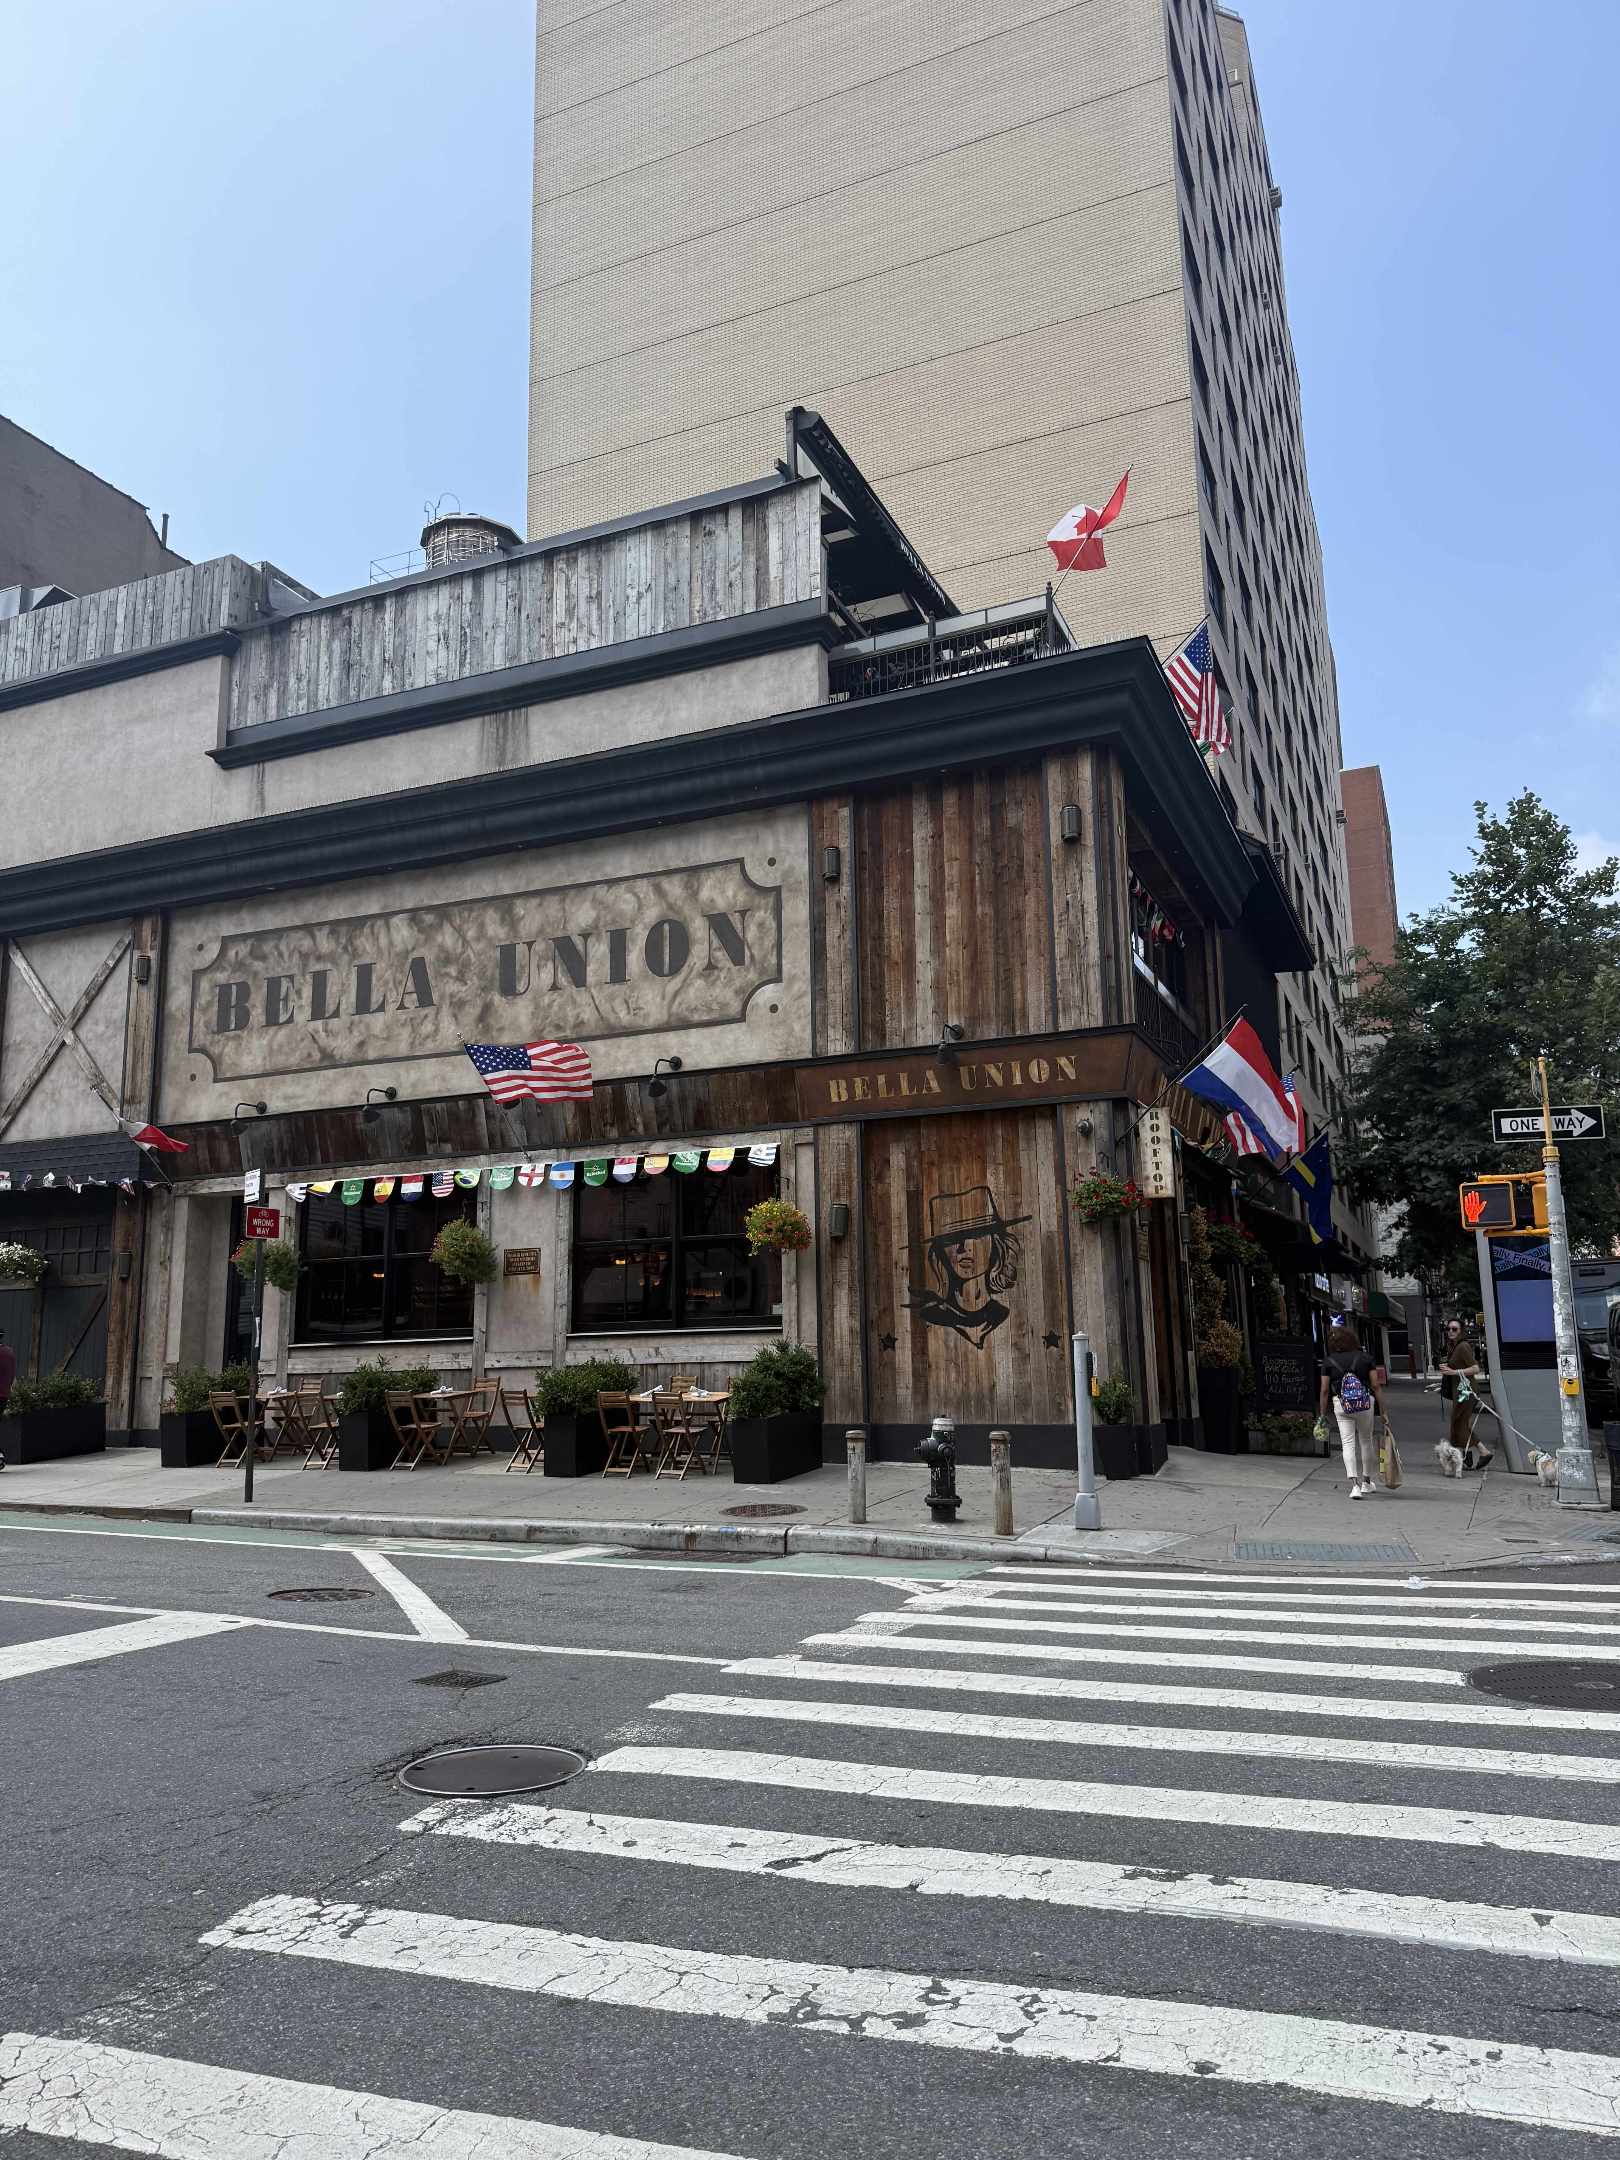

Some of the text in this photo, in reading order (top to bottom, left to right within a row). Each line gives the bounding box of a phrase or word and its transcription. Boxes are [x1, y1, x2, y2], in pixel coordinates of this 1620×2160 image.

[213, 909, 751, 1034] BELLA UNION
[827, 1055, 1079, 1103] BELLA UNION
[1510, 1117, 1585, 1131] ONE WAY
[1149, 1111, 1164, 1195] ROOFTOP
[252, 1218, 275, 1227] WRONG
[256, 1227, 270, 1235] WAY
